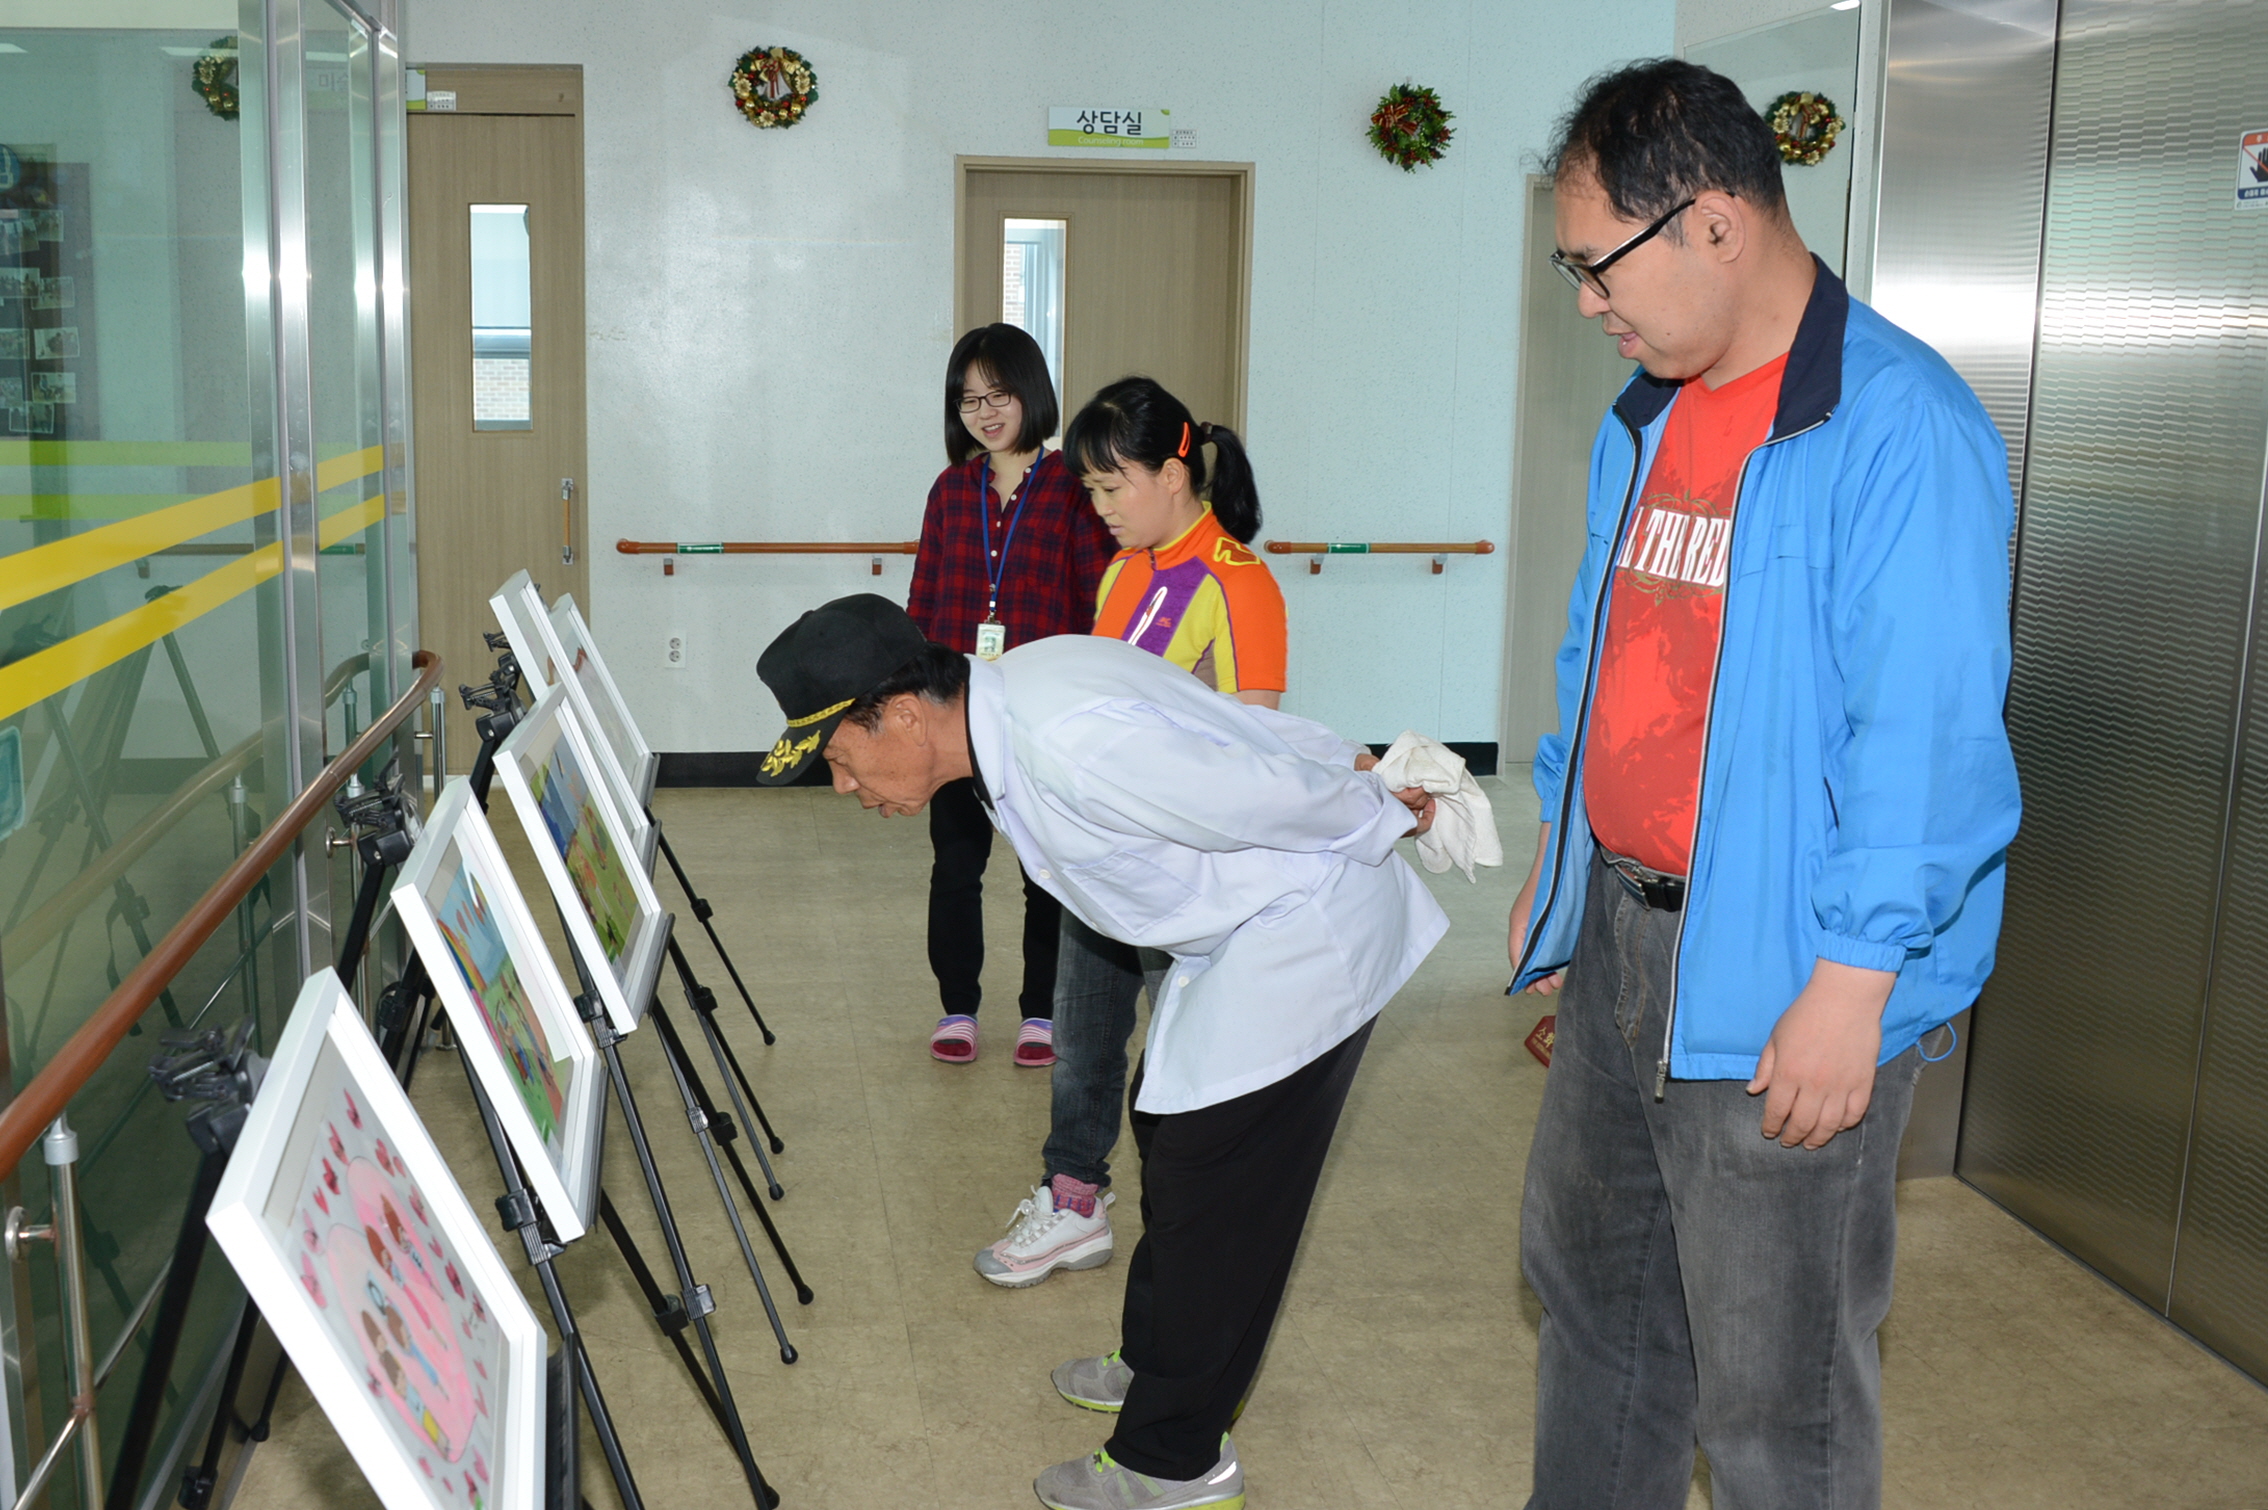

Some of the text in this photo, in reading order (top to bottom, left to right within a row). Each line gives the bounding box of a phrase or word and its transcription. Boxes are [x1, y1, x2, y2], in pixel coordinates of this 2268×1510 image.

[1077, 110, 1142, 136] 상담실
[1077, 136, 1144, 147] Counseling room
[1616, 506, 1645, 568] L
